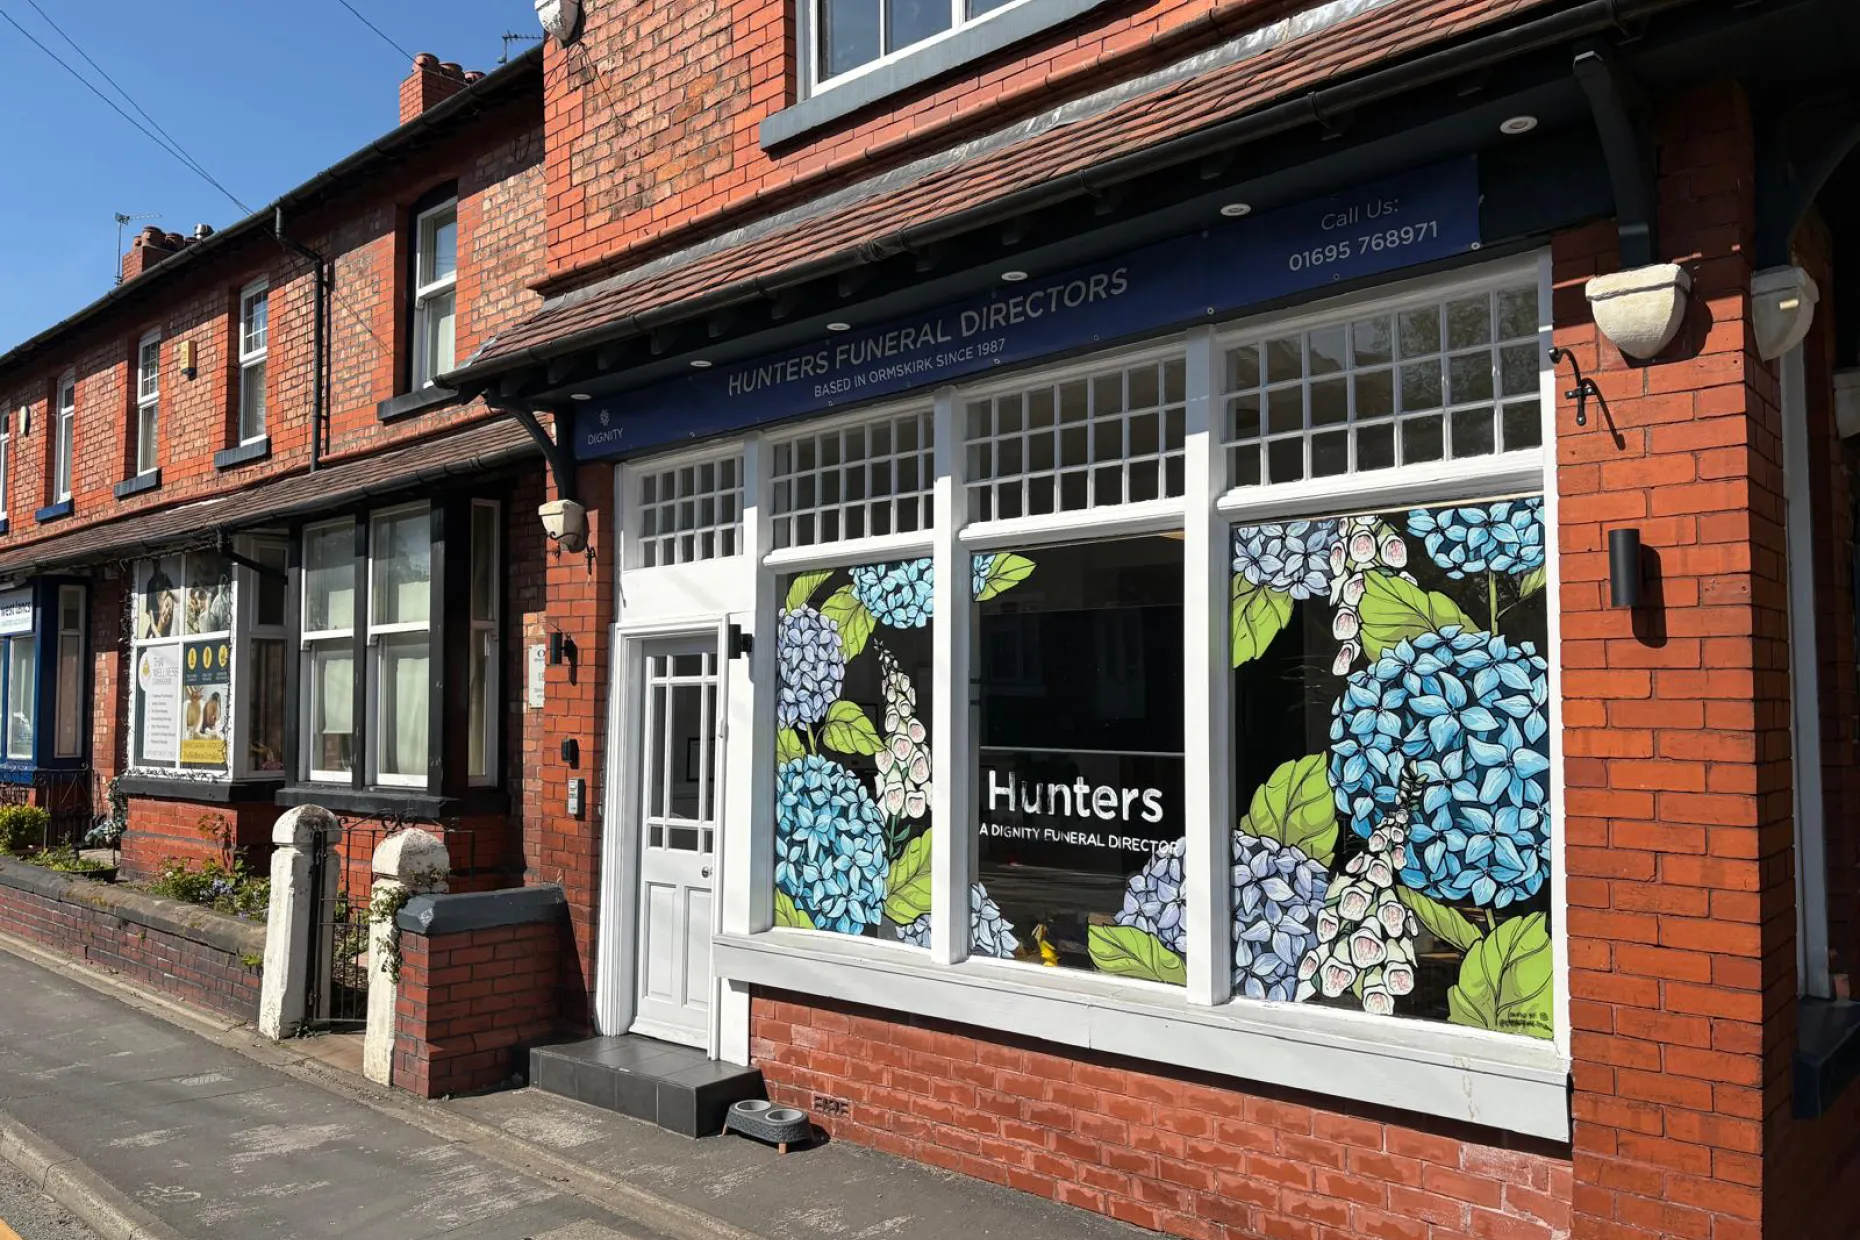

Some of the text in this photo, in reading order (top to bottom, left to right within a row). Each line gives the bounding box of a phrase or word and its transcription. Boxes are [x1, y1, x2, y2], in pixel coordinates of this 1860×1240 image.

[1321, 199, 1399, 230] Call Us:
[1289, 220, 1438, 271] 01695 768971
[728, 267, 1128, 396] HUNTERS FUNERAL DIRECTORS
[814, 338, 1006, 397] BASED IN ORMSKIRK SINCE 1987
[587, 427, 623, 445] DIGNITY
[988, 770, 1163, 823] Hunters
[979, 822, 989, 836] A
[991, 823, 1040, 840] DIGNITY
[1044, 828, 1106, 847] FUNERAL
